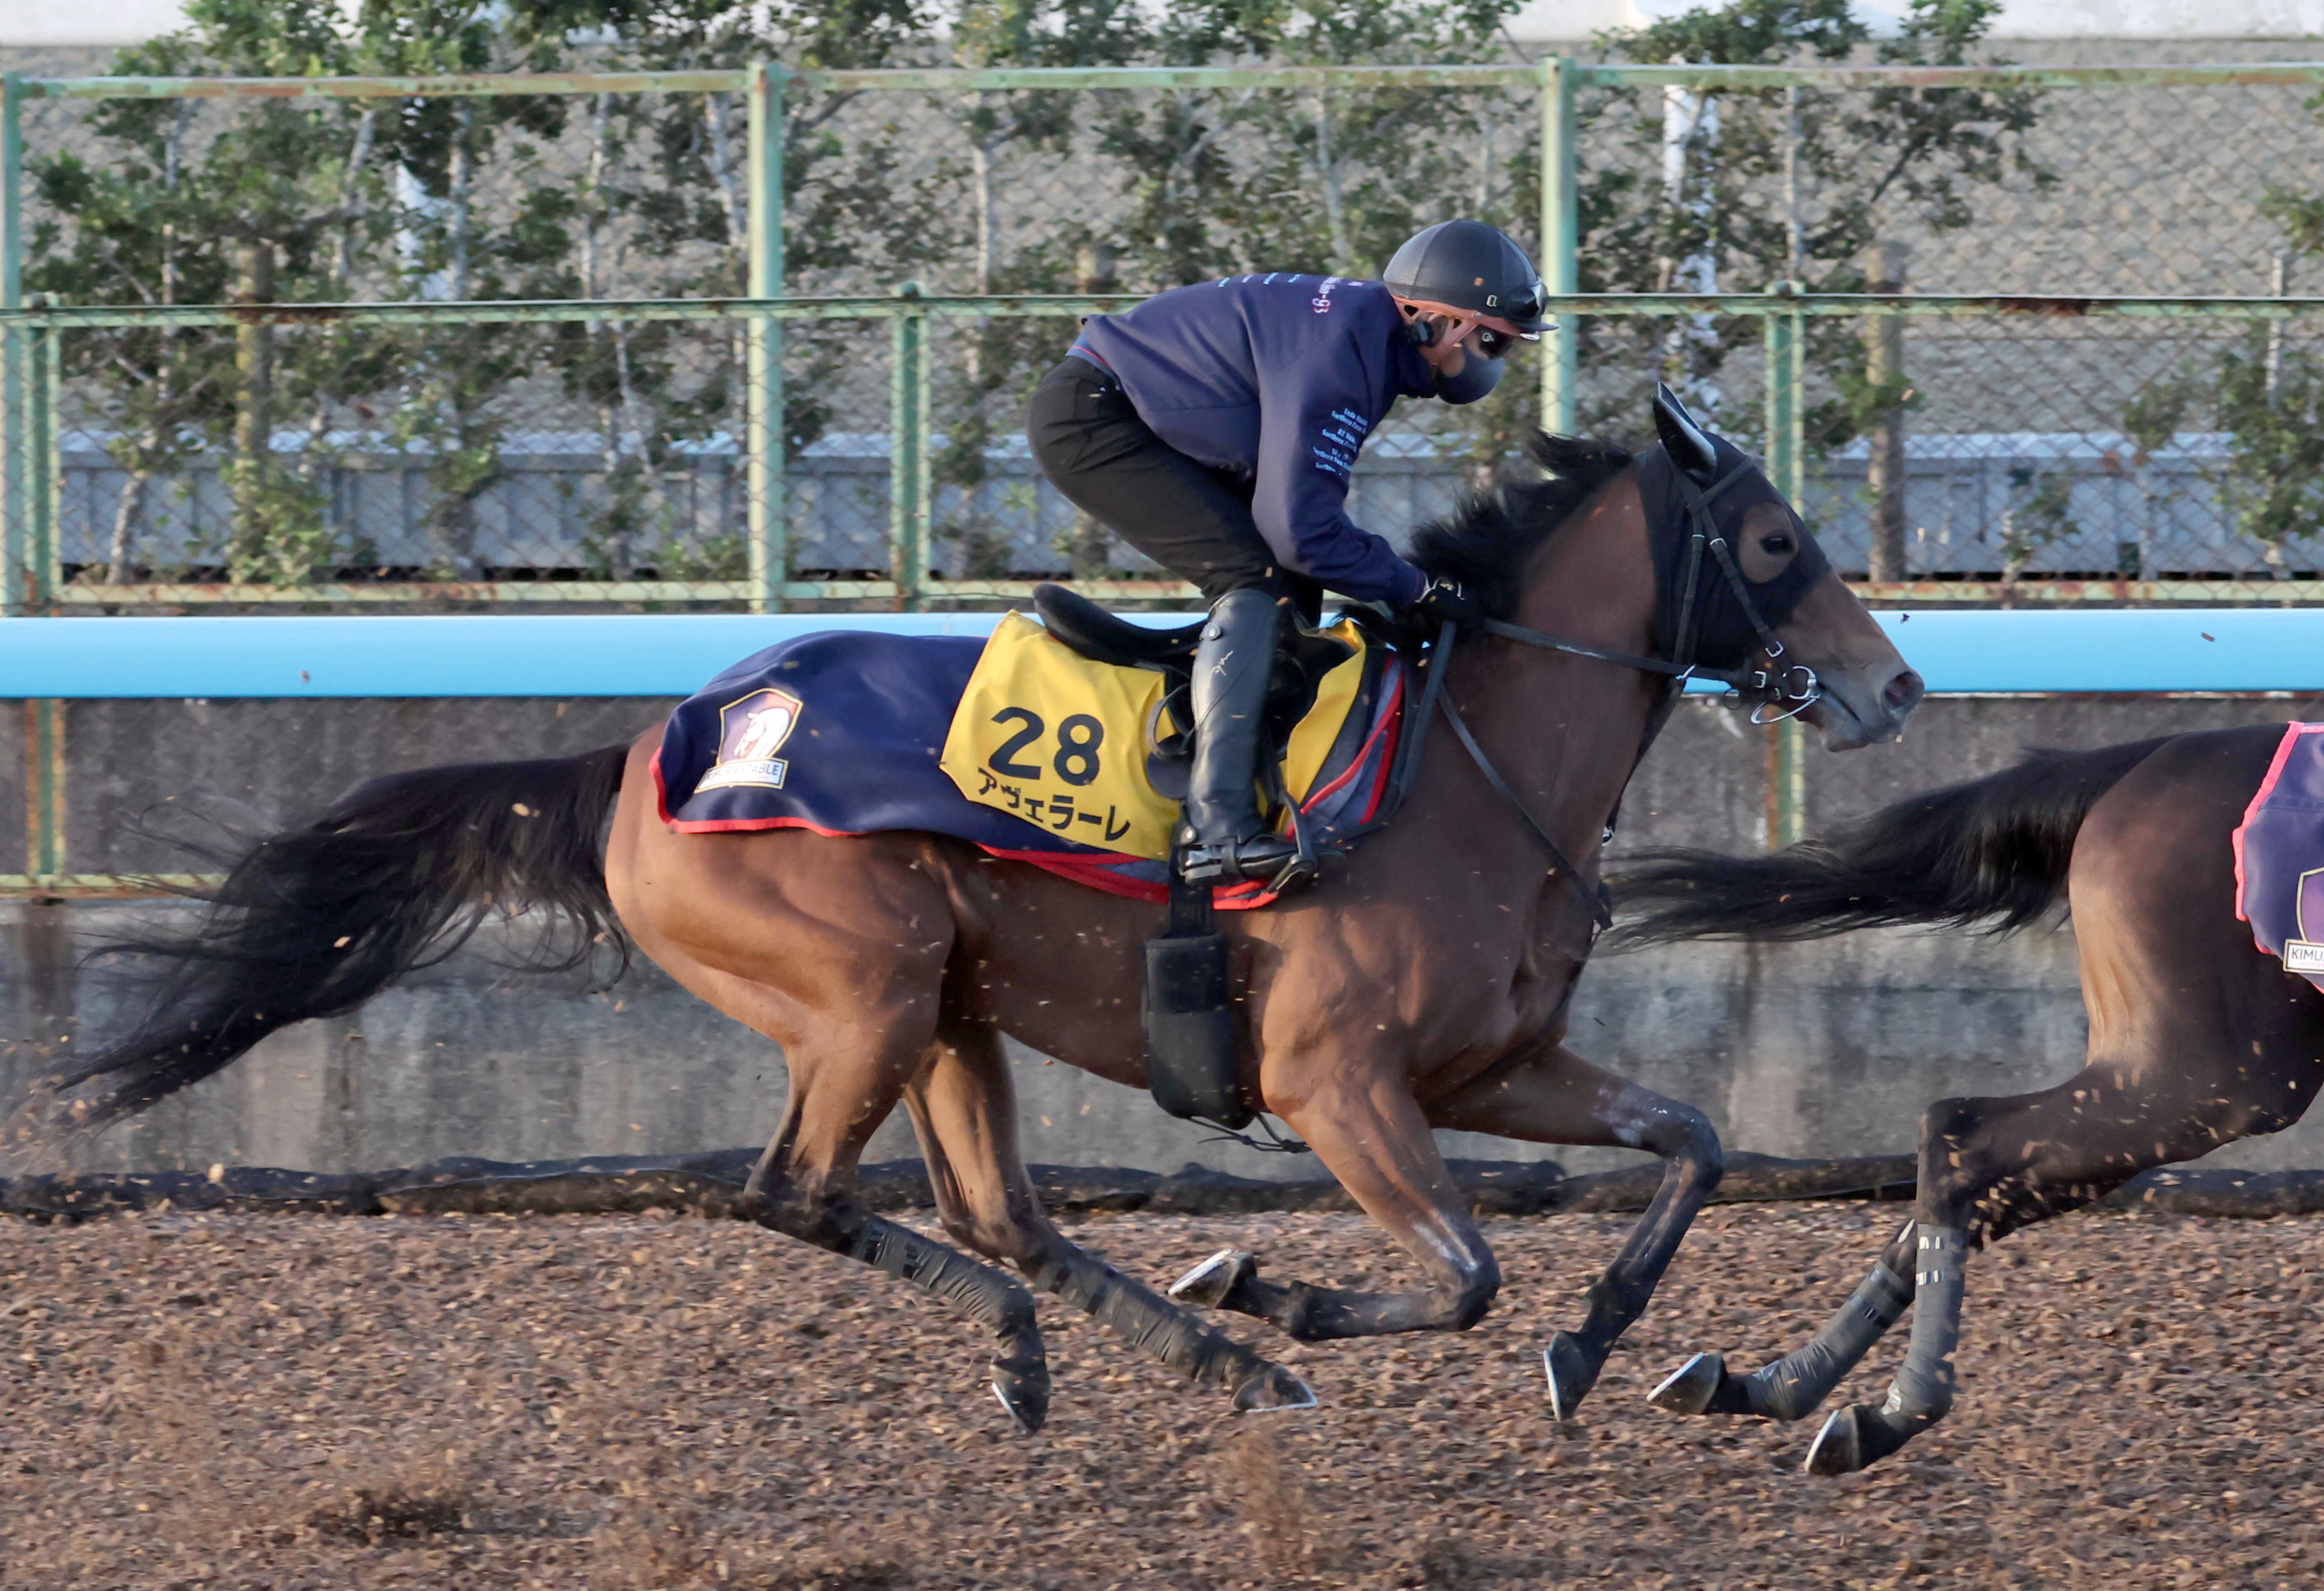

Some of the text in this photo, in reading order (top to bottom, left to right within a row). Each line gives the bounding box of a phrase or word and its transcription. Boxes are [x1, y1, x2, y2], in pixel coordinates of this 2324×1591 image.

[989, 706, 1104, 786] 28
[978, 767, 1131, 841] アヴェラーレ
[2291, 948, 2324, 962] KIMU
